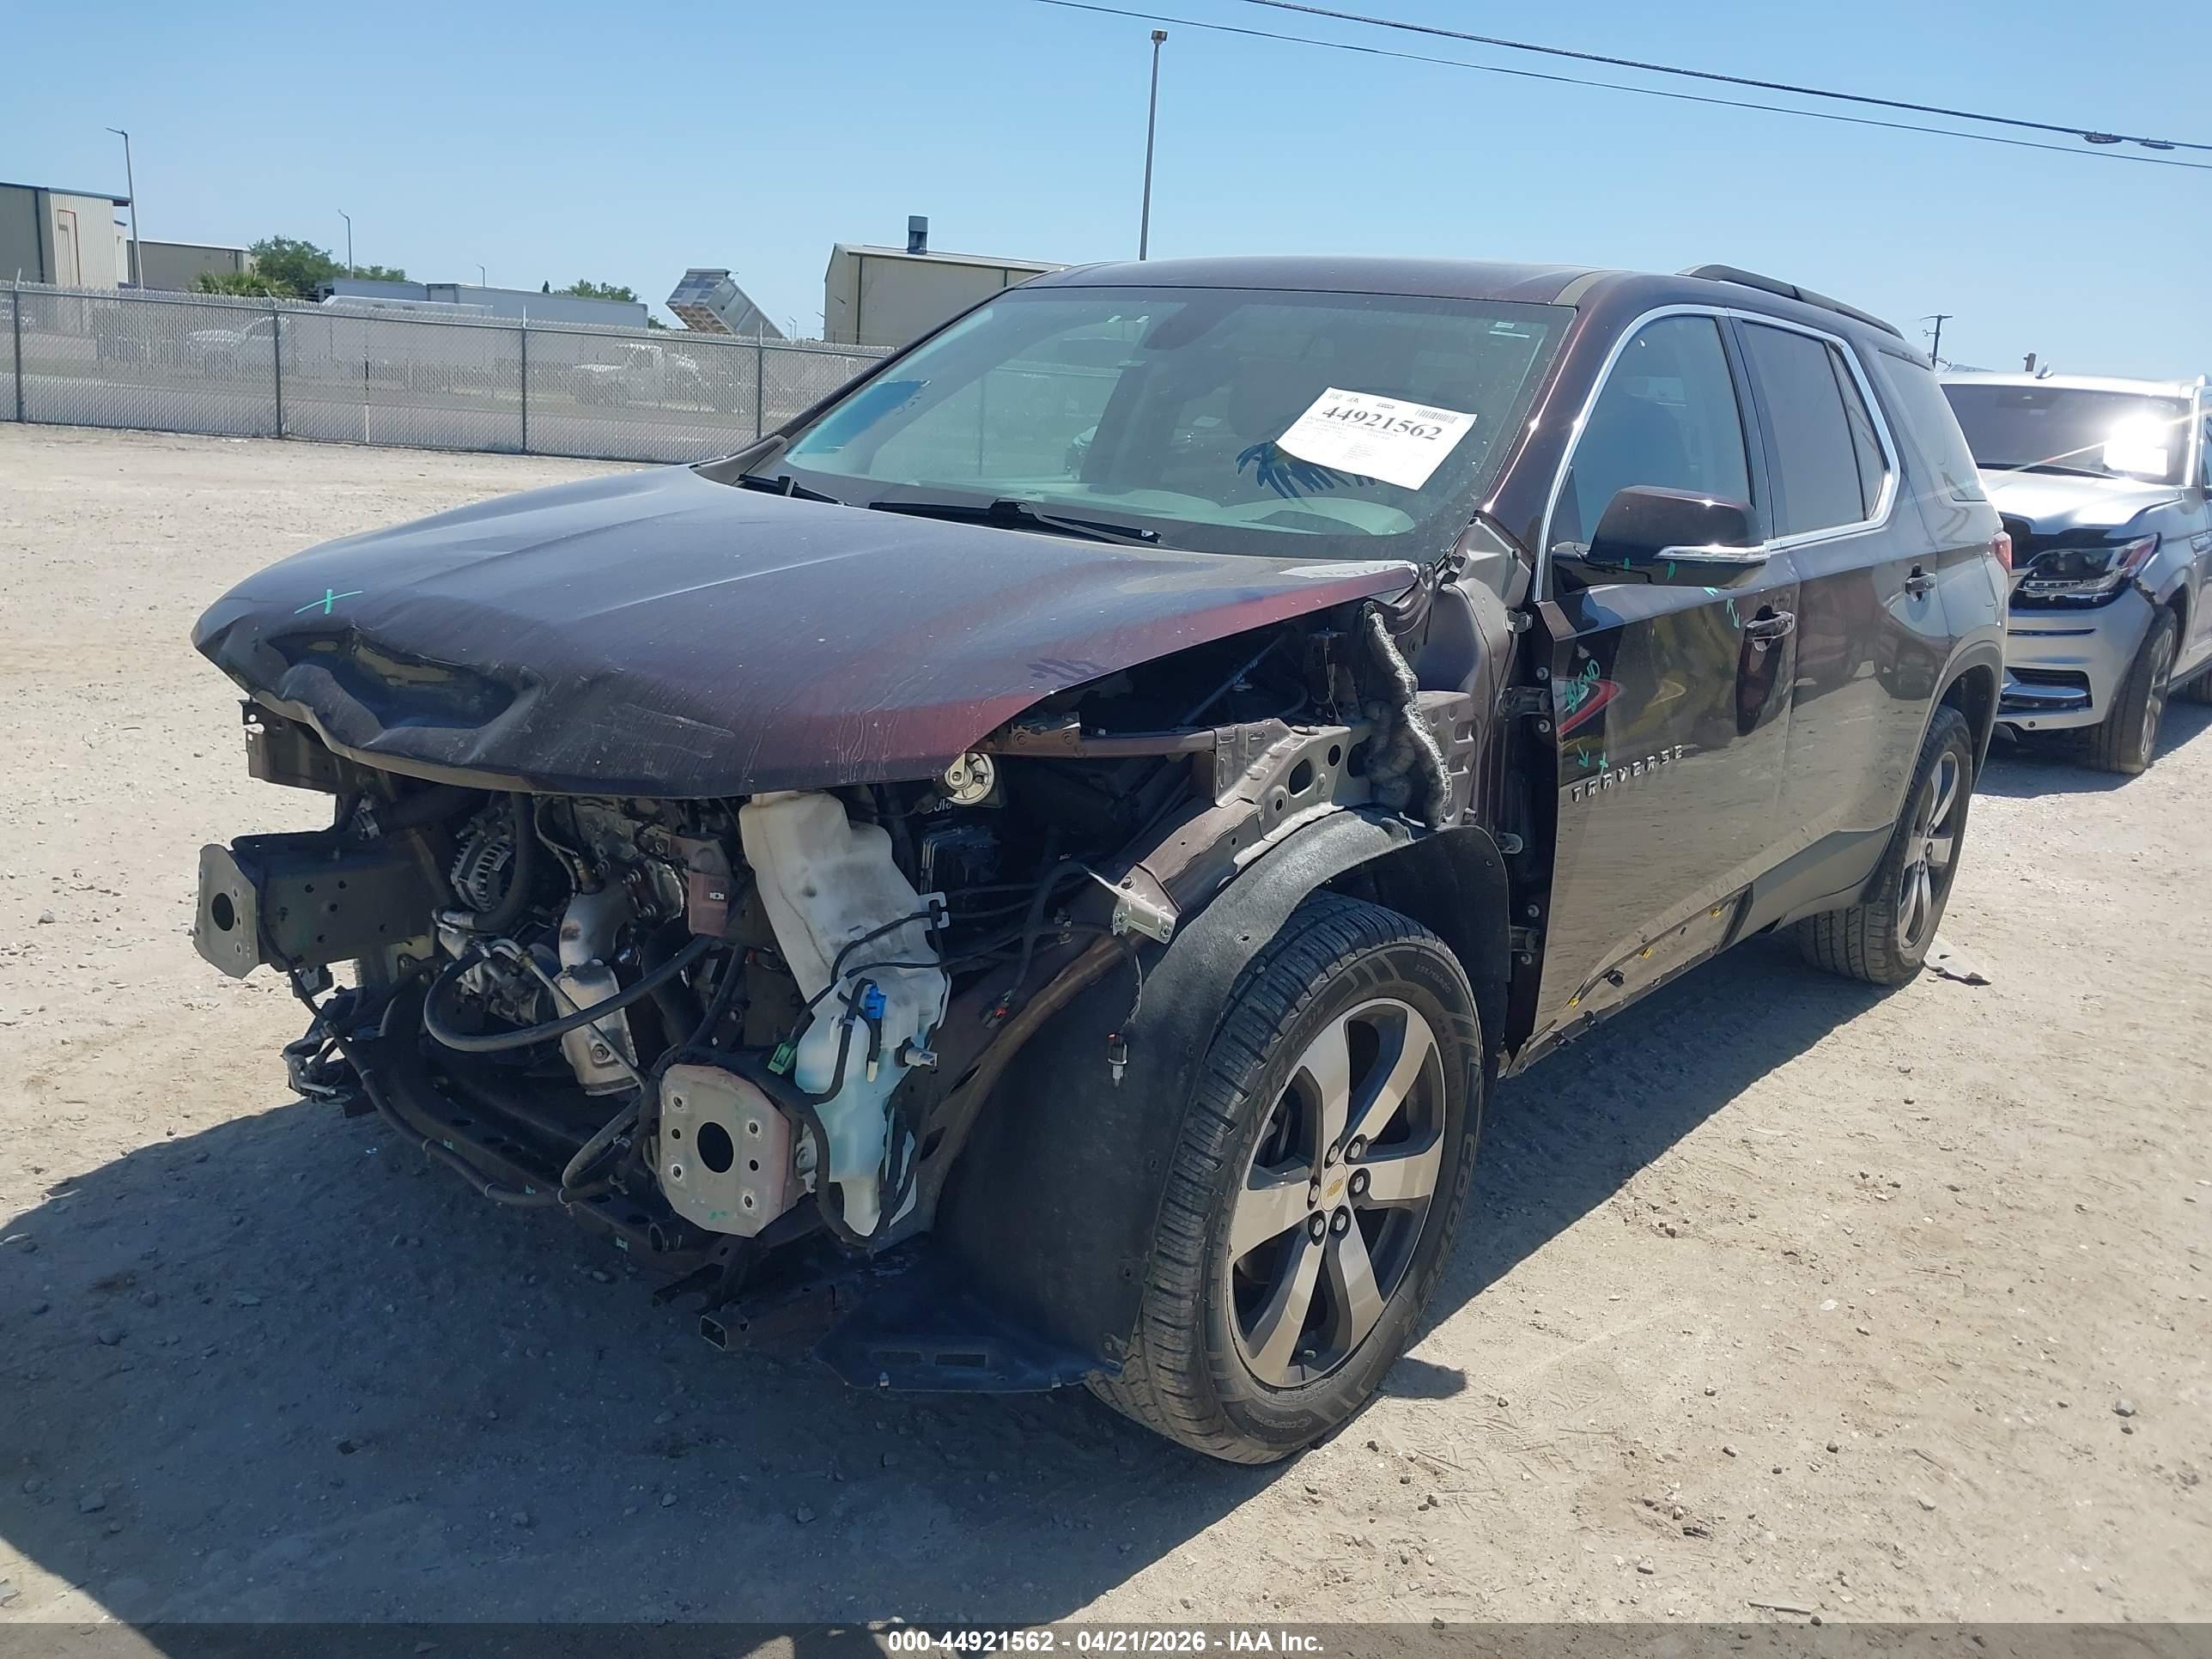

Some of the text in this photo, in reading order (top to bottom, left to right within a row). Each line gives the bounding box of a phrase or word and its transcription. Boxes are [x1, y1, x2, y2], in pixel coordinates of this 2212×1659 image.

[1322, 405, 1444, 441] 44921562
[1571, 744, 1684, 803] TRAVERSE
[1403, 1132, 1475, 1337] COOPER
